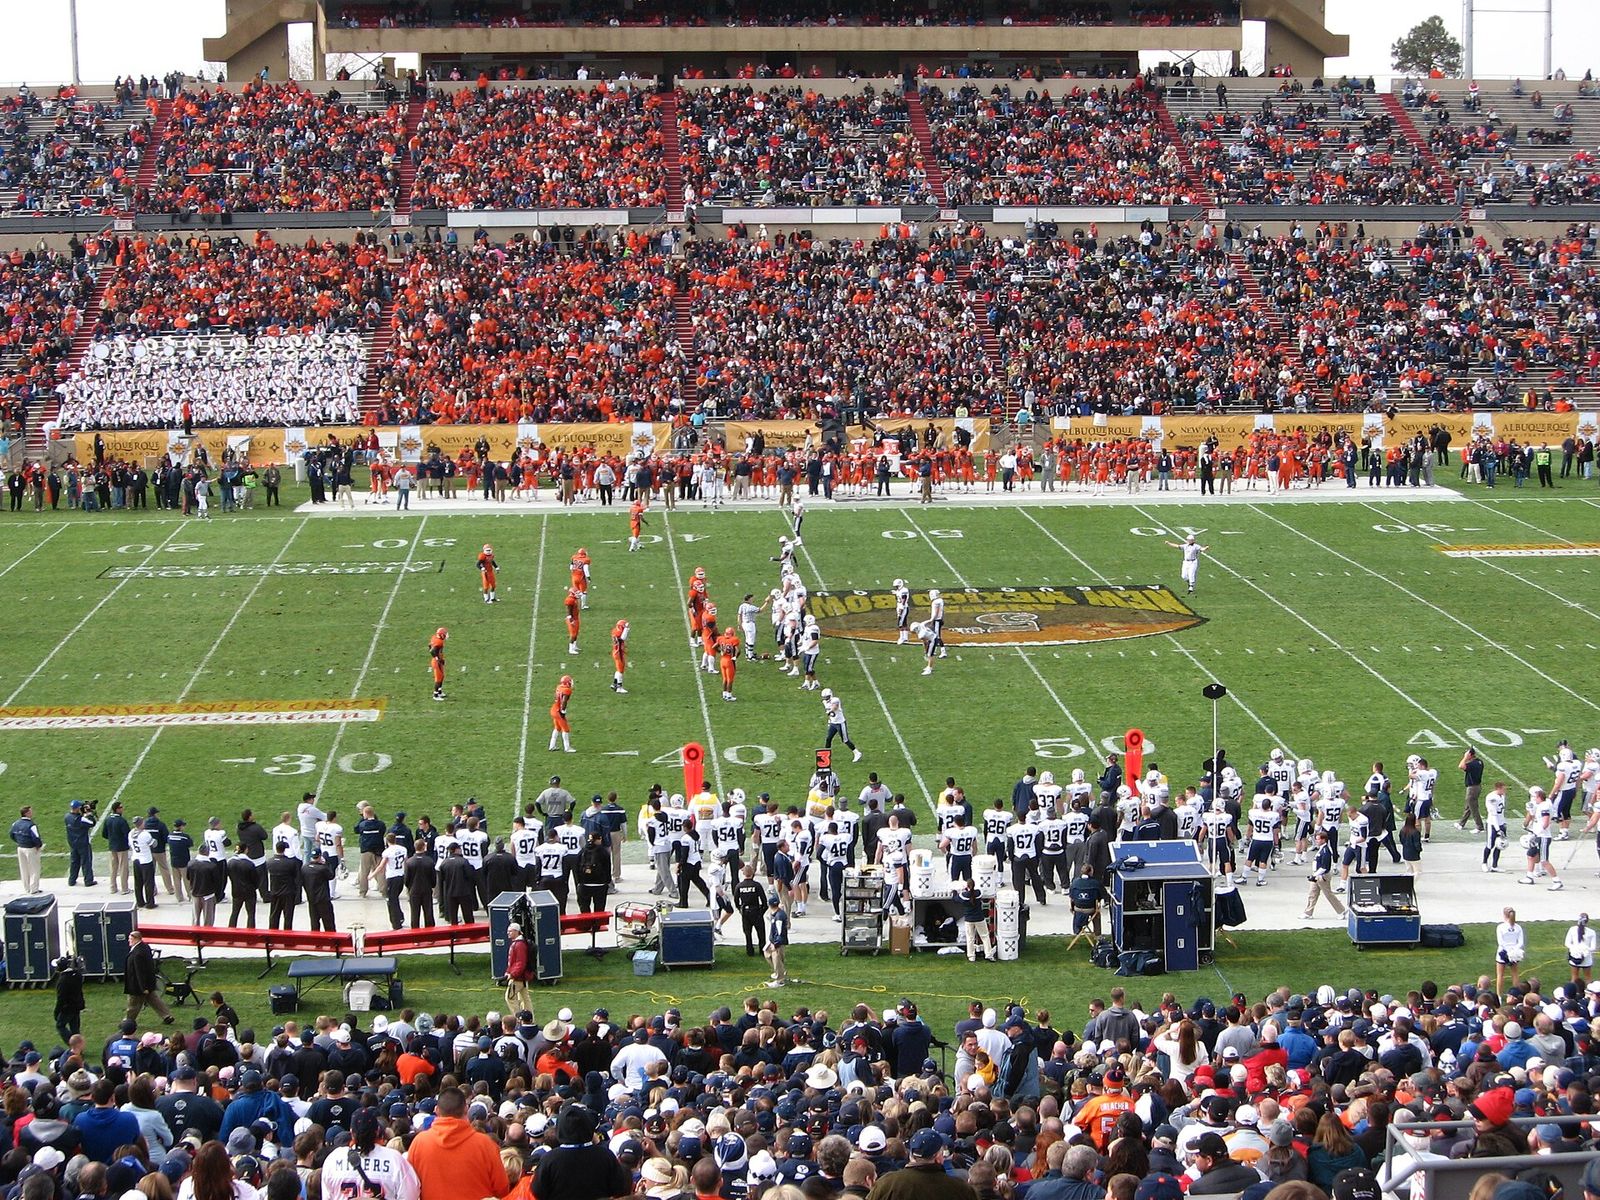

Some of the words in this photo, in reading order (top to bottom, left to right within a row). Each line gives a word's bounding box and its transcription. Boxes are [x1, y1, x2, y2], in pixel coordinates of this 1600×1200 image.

[1062, 426, 1133, 437] ALBUQUERQUE
[1201, 425, 1236, 433] MEXICO
[1502, 423, 1570, 433] ALBUQUERQUE
[550, 433, 624, 443] ALBUQUERQUE
[86, 441, 160, 452] AUQUERQUE
[373, 538, 457, 549] 30
[806, 594, 896, 619] BOW
[911, 590, 1077, 608] MEXICO
[1083, 589, 1194, 616] NEW
[0, 703, 239, 717] ENCHANTMEN
[1406, 727, 1523, 749] 40
[263, 752, 393, 775] 30
[651, 744, 777, 768] 40
[817, 750, 831, 768] 3
[1038, 794, 1055, 808] 33
[1326, 807, 1341, 822] 52
[719, 826, 736, 841] 54
[988, 819, 1005, 834] 26
[1069, 822, 1086, 836] 27
[1254, 819, 1271, 834] 95
[319, 832, 334, 847] 56
[1016, 834, 1033, 849] 67
[1047, 829, 1060, 842] 13
[462, 841, 478, 857] 66
[519, 838, 535, 854] 97
[830, 842, 847, 857] 46
[957, 837, 973, 852] 68
[543, 854, 560, 869] 77
[335, 1158, 391, 1173] MIERS
